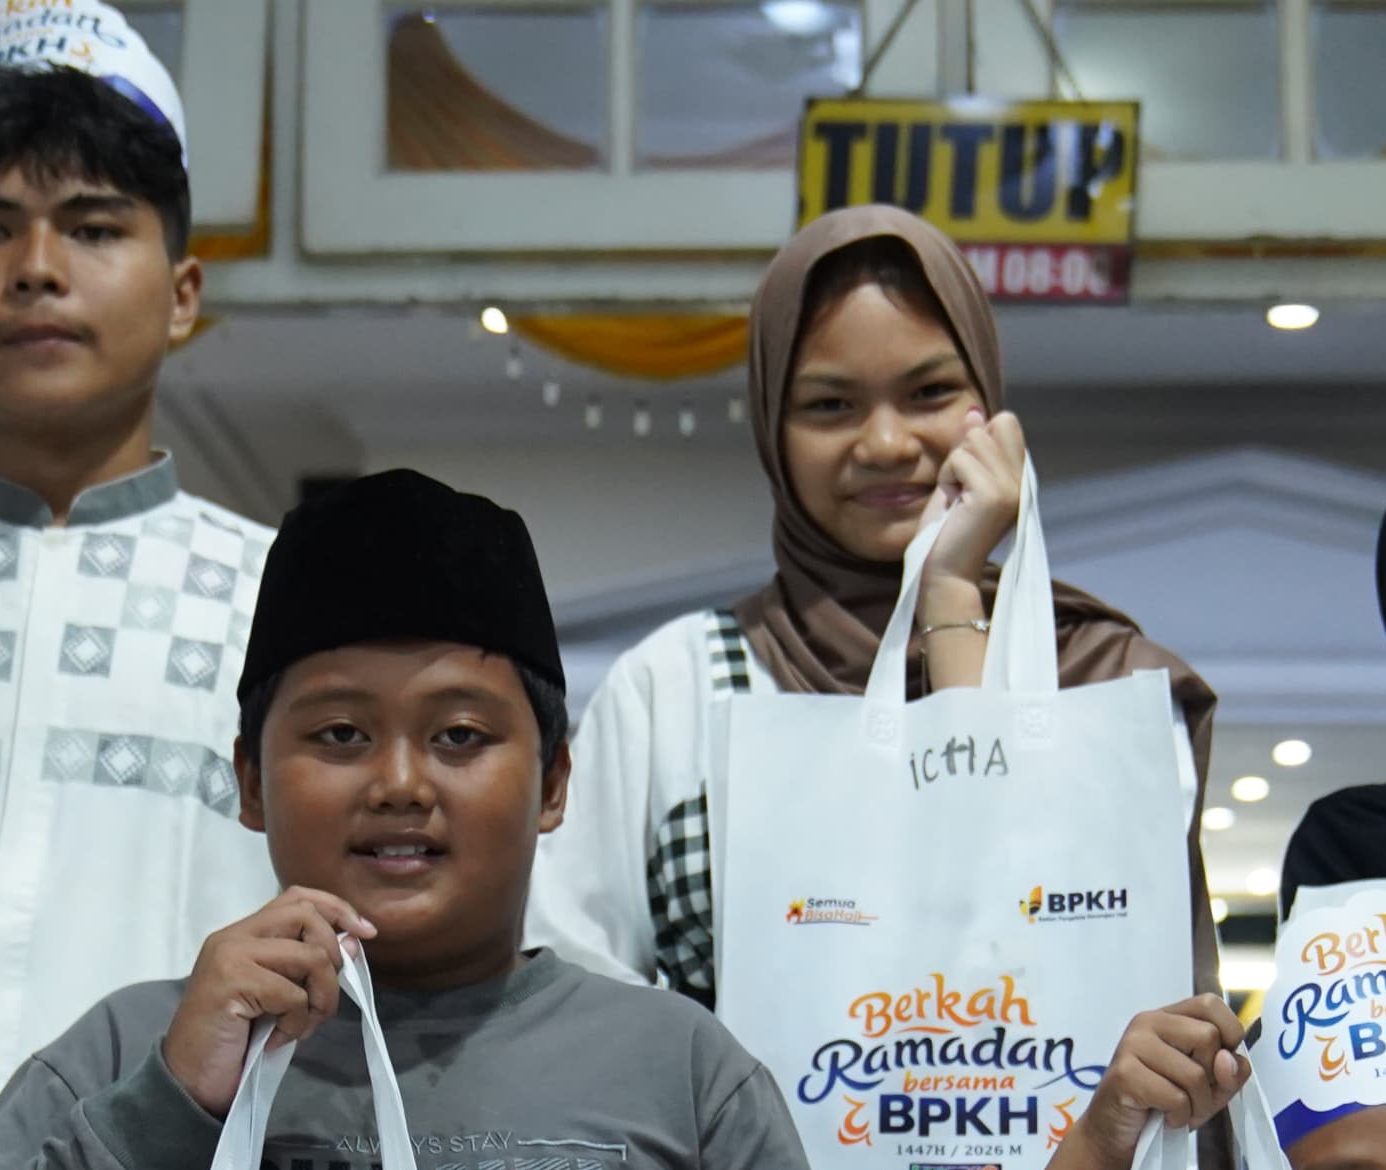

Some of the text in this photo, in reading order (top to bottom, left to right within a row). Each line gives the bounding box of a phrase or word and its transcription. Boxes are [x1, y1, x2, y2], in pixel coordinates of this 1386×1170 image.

[815, 122, 1124, 222] TUTUP
[807, 897, 856, 909] Semua
[1047, 888, 1128, 913] BPKH
[848, 973, 1038, 1039] Berkah
[797, 1026, 1112, 1105] Ramadan
[903, 1071, 1016, 1093] bersama
[879, 1093, 1039, 1137] BPKH
[449, 1130, 513, 1152] STAY
[897, 1143, 945, 1156] 1447H
[965, 1144, 1004, 1157] 2026
[1009, 1144, 1022, 1156] M
